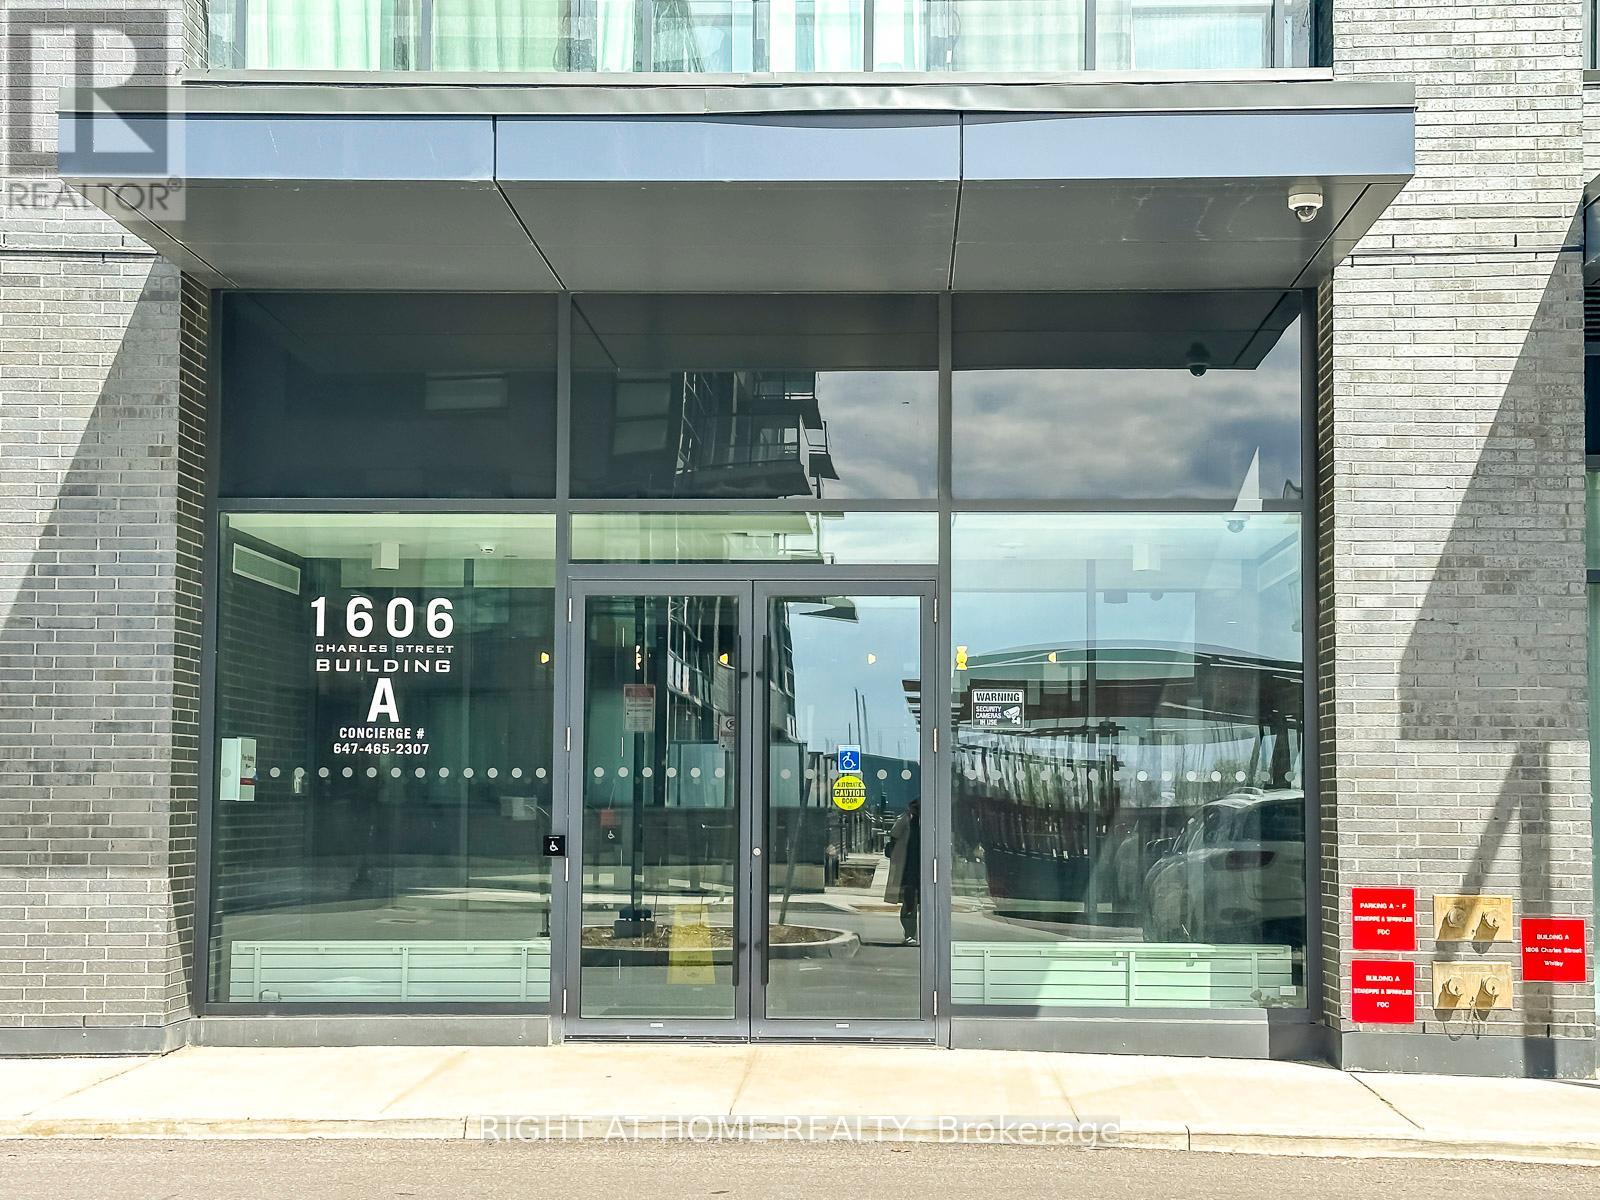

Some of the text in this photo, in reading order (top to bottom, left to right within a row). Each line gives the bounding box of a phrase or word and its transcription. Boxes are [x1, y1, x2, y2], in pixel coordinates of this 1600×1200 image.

[311, 596, 454, 639] 1606
[315, 644, 454, 654] CHARLES STREET
[316, 658, 451, 673] BUILDING
[366, 677, 400, 723] A
[976, 692, 1020, 702] WARNING
[339, 727, 425, 739] CONCIERGE #
[333, 743, 430, 755] 647-465-2307
[834, 789, 866, 797] CAUTION
